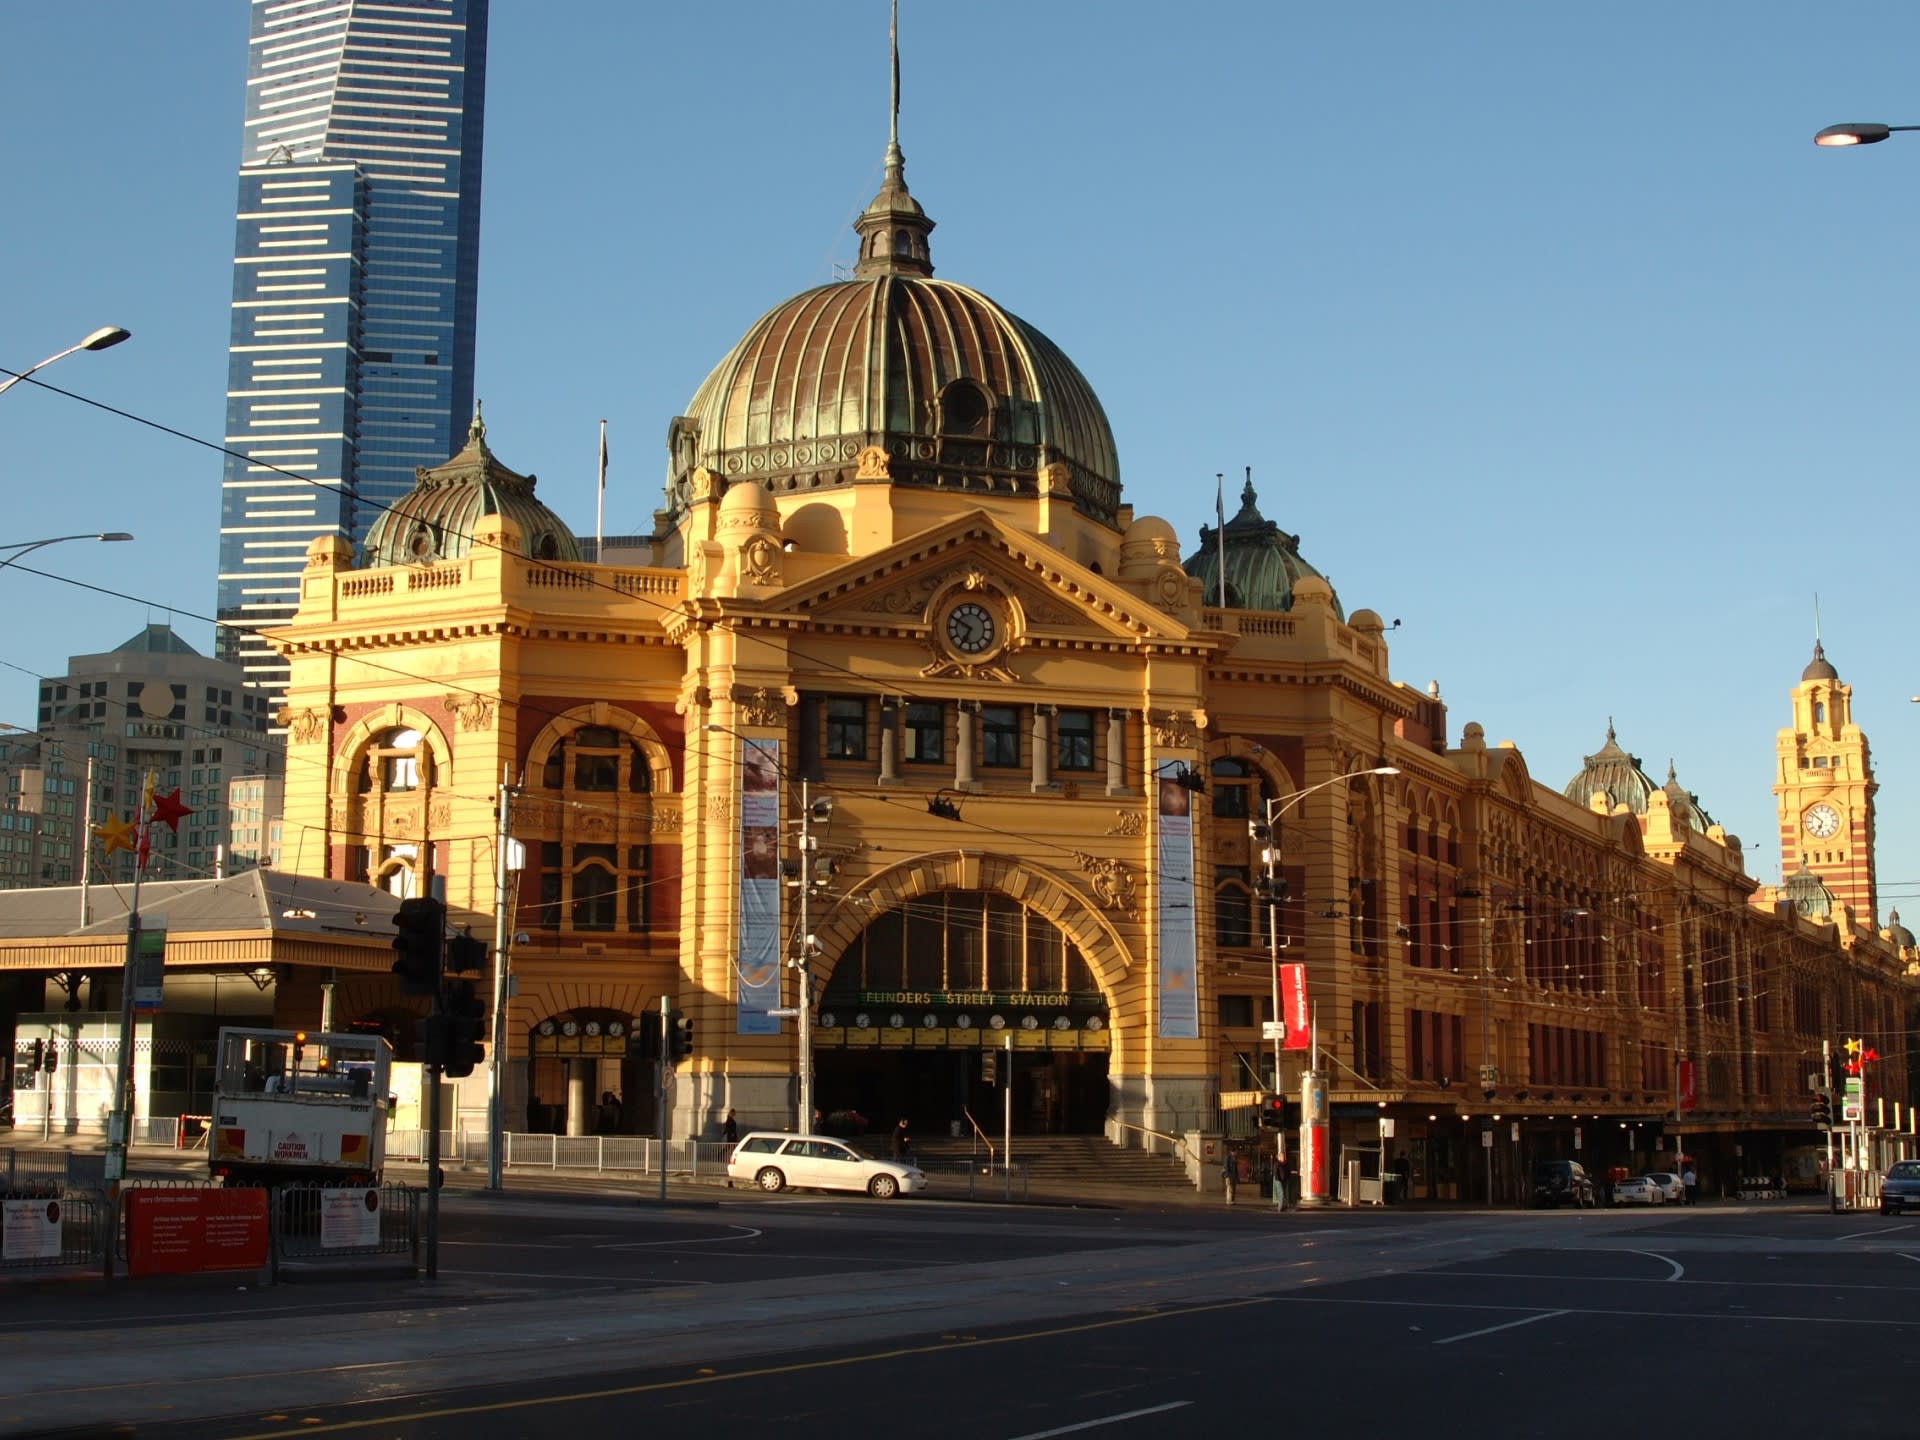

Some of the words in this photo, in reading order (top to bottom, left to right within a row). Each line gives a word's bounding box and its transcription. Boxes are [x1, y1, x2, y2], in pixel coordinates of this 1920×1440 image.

[866, 992, 931, 1004] FLINDERS
[947, 992, 995, 1006] STREET
[1010, 993, 1070, 1006] STATION
[278, 1142, 306, 1150] CAUTION
[274, 1150, 308, 1159] WORKMEN
